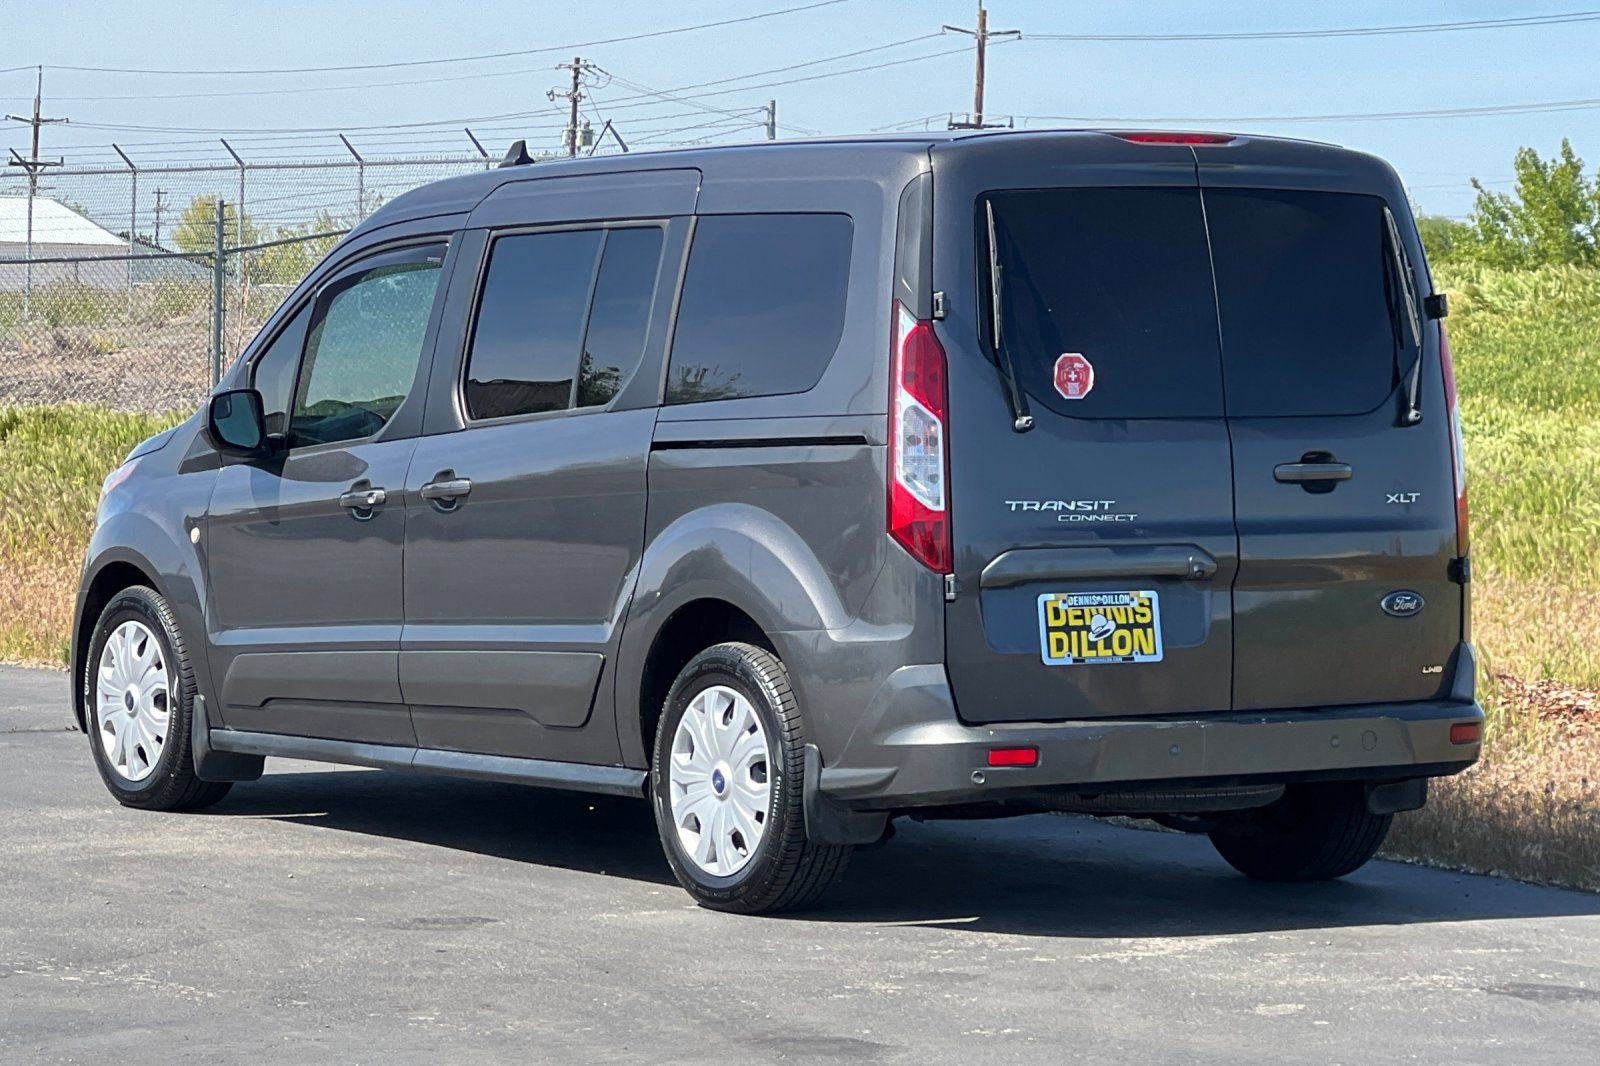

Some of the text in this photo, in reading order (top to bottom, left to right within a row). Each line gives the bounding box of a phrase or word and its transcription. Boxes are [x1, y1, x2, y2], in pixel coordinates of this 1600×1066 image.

[1386, 492, 1421, 504] XLT
[1005, 500, 1116, 512] TRANSIT
[1058, 514, 1138, 522] CONNECT
[1068, 594, 1130, 606] DENNIS DILLON
[1393, 596, 1417, 611] Ford
[1048, 628, 1155, 659] DILLON
